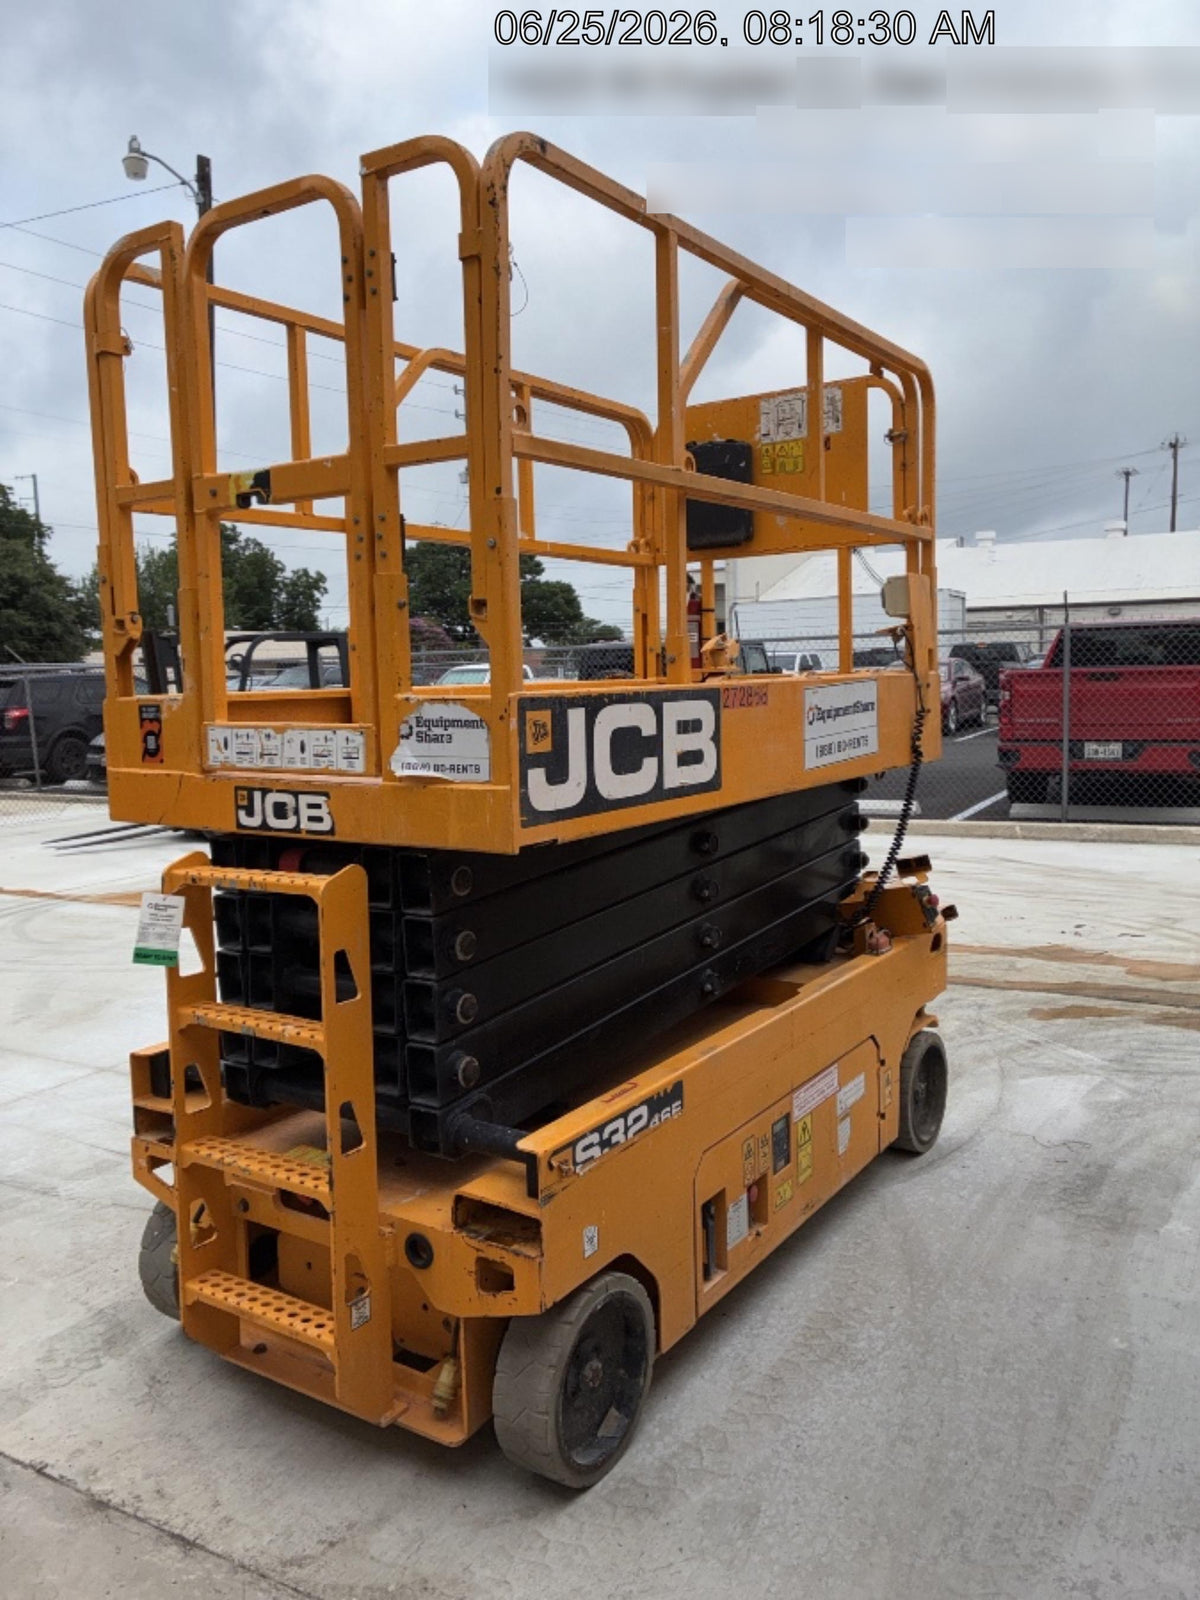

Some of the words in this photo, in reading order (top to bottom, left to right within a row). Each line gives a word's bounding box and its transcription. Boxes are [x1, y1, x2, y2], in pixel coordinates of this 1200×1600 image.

[415, 716, 486, 731] Equipment
[415, 730, 453, 744] Share
[527, 699, 718, 812] JCB
[238, 790, 333, 831] JCB
[575, 1104, 649, 1166] S32
